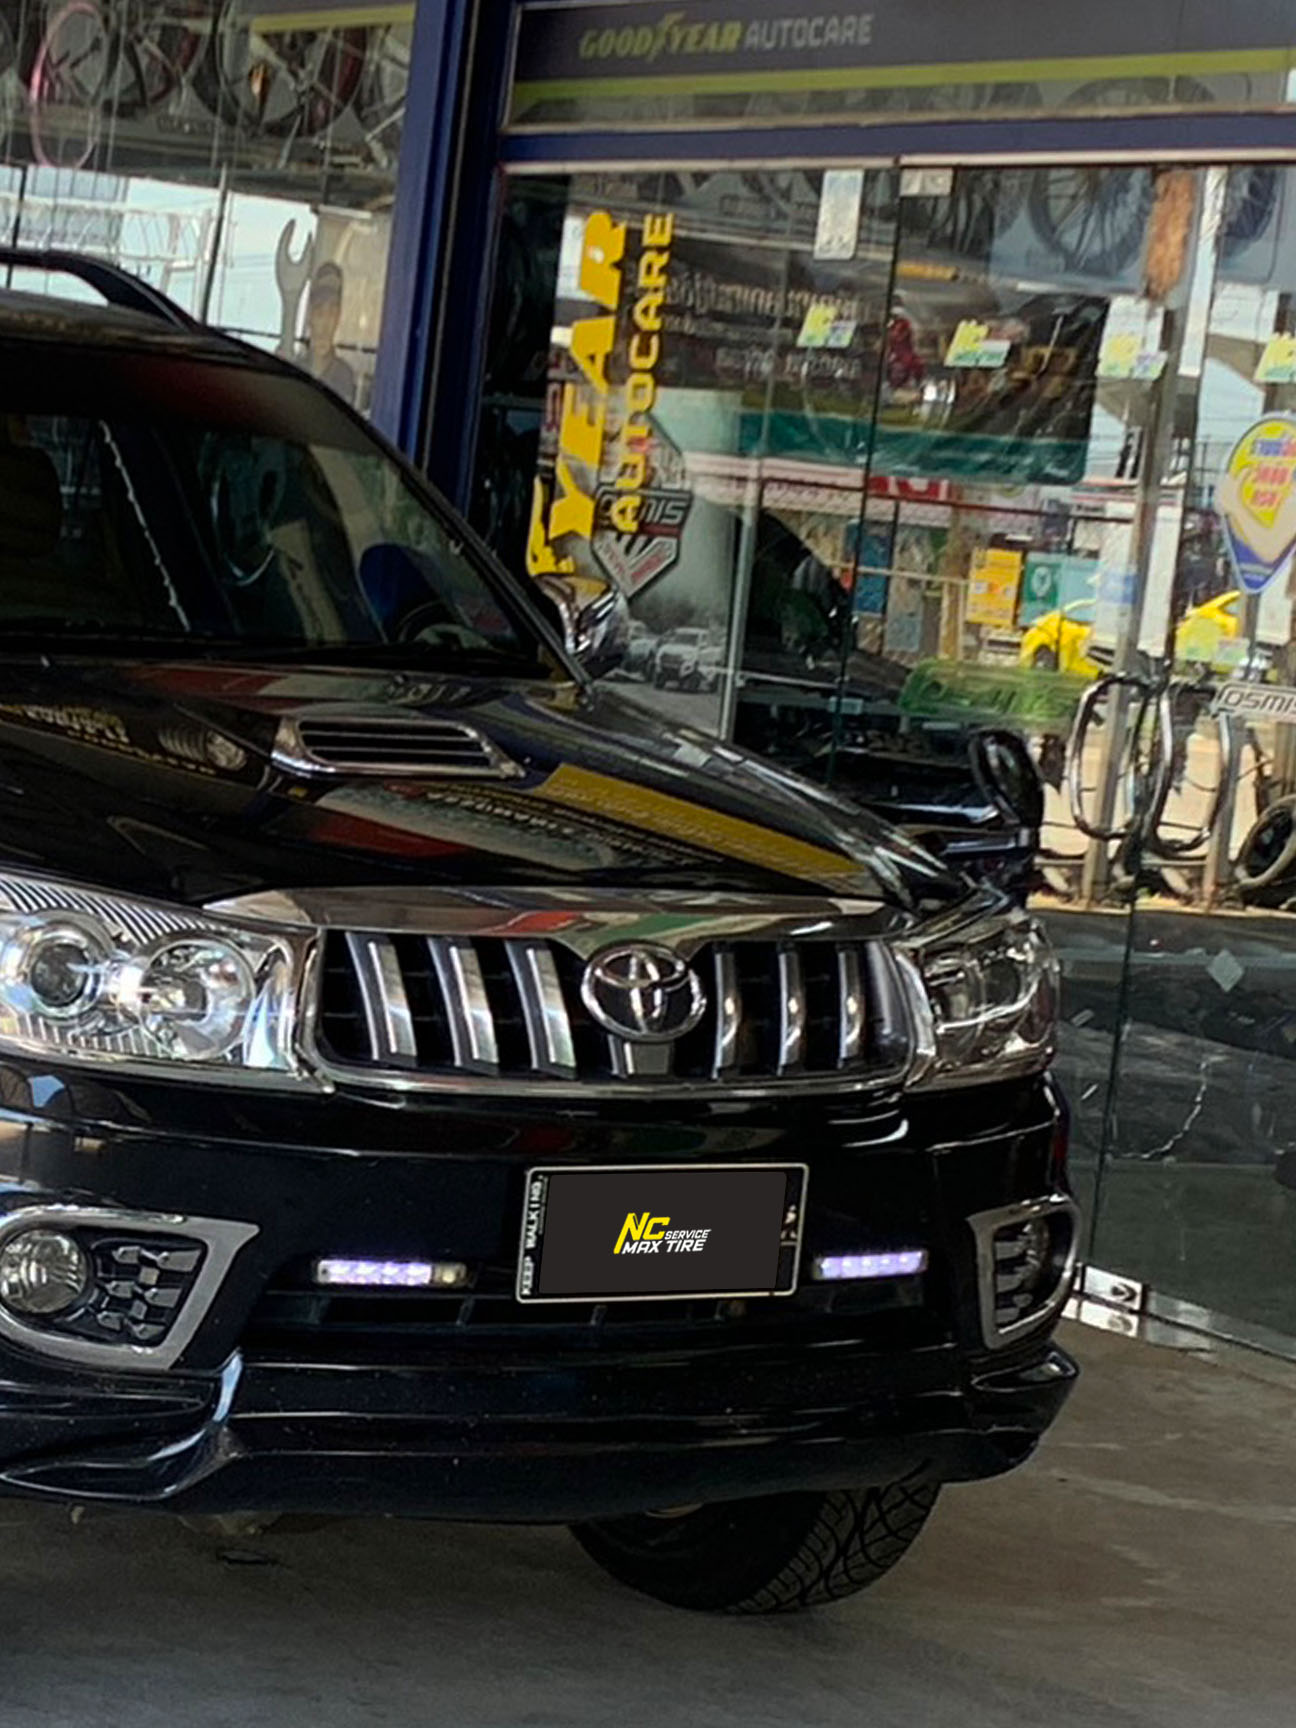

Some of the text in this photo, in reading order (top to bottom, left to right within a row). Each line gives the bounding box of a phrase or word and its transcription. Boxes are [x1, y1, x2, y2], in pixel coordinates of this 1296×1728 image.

[578, 12, 874, 61] GOODYEAR AUTOCARE
[611, 212, 674, 534] AUTOCARE
